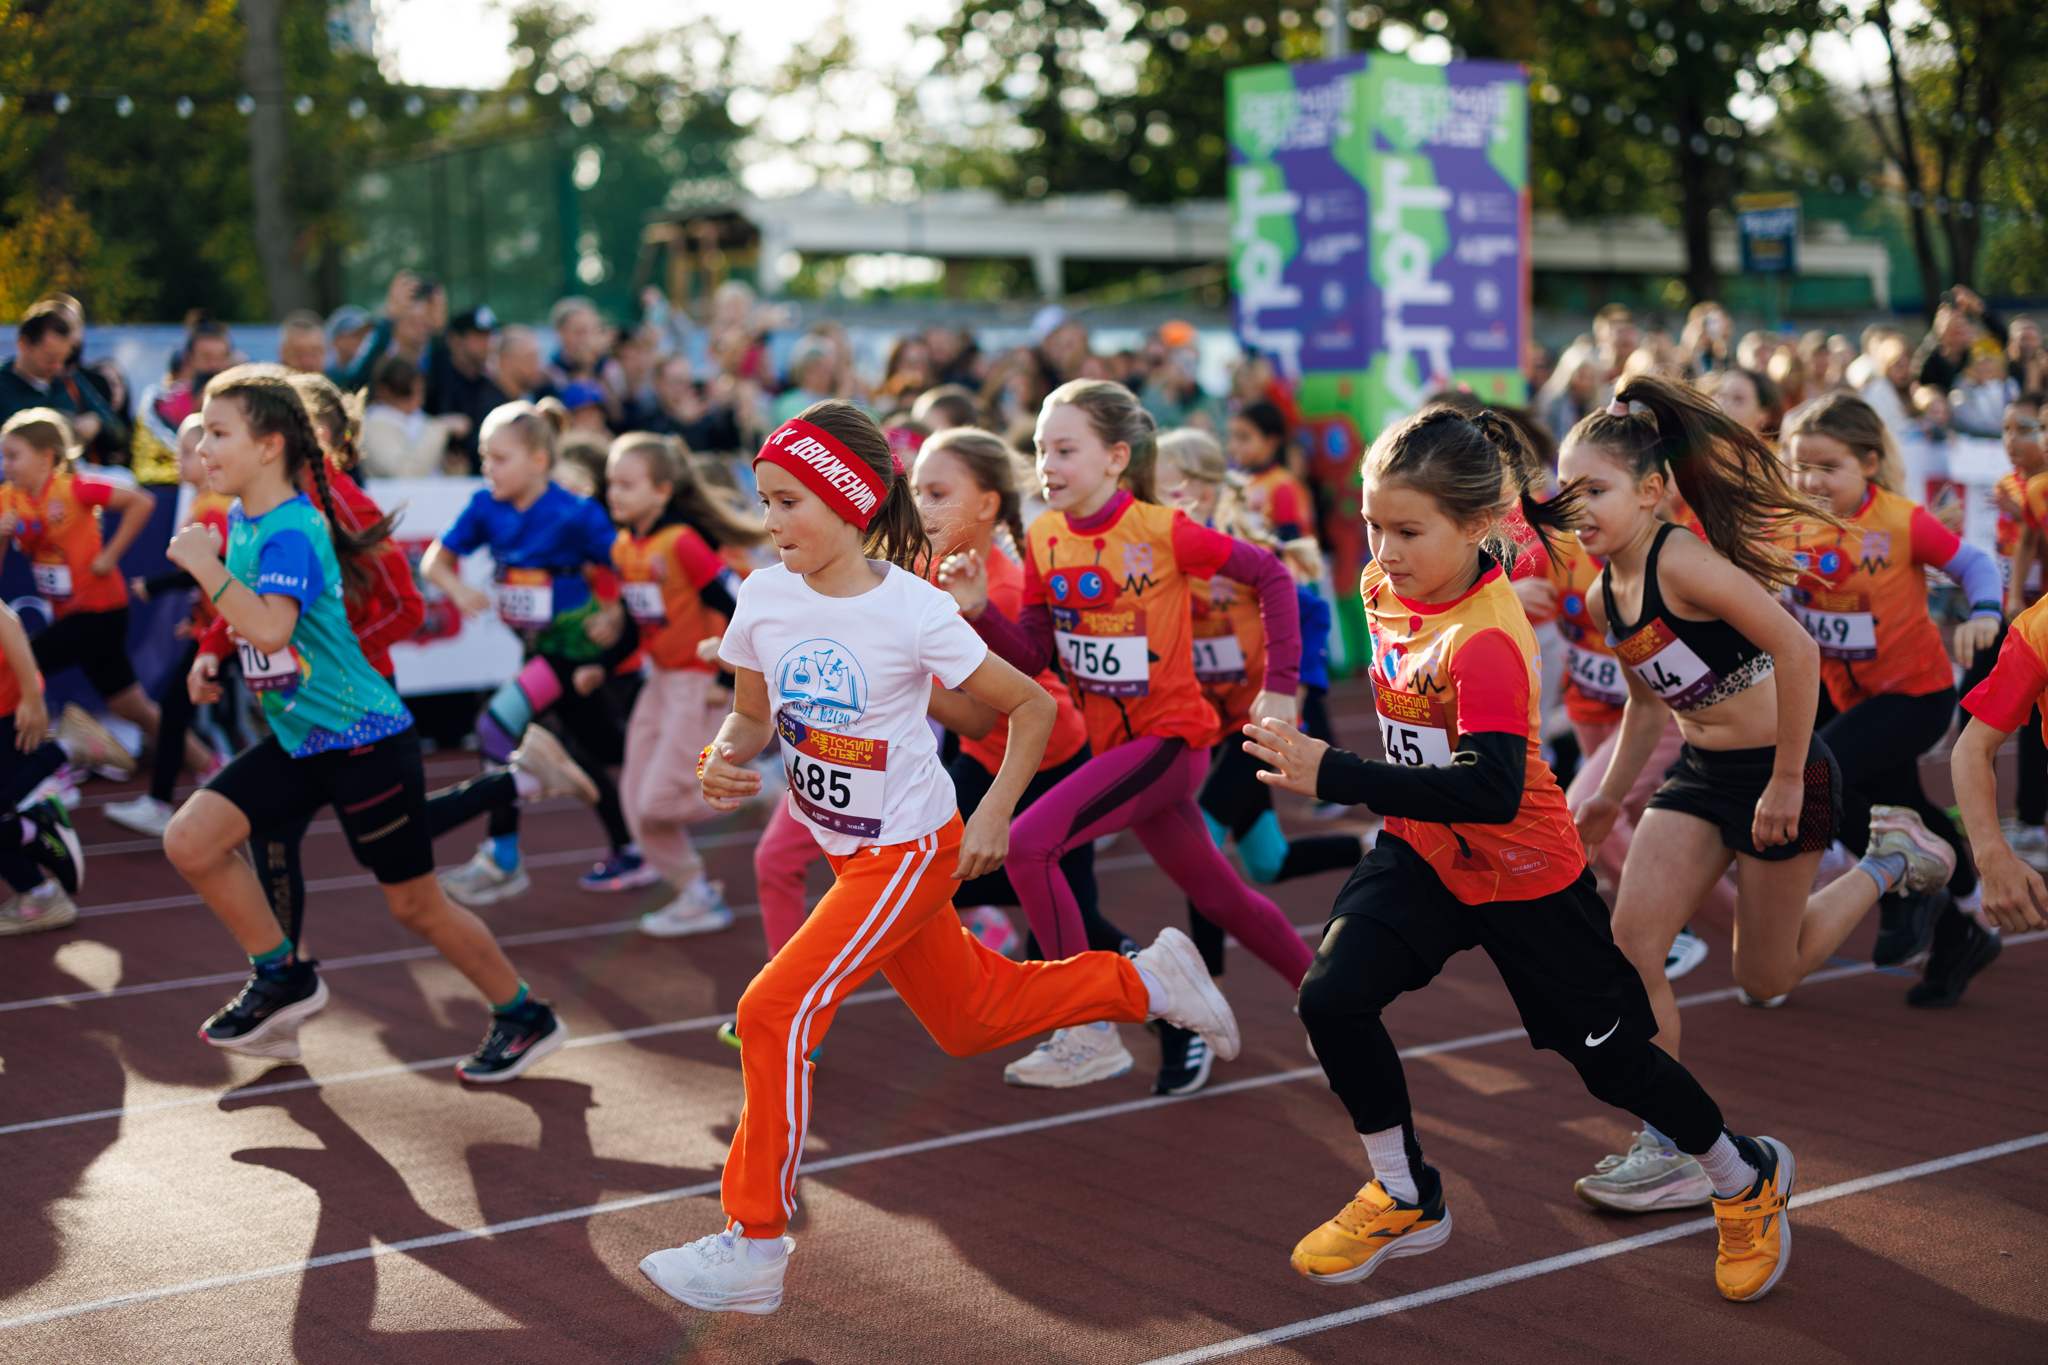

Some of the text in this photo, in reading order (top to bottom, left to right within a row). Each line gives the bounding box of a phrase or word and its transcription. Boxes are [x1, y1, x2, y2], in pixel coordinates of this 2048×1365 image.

[771, 428, 877, 515] К ДВИЖЕНИЮ
[1069, 640, 1120, 675] 756
[1639, 661, 1682, 694] 44
[1379, 687, 1430, 709] ДЕТСКИЙ
[811, 730, 874, 752] ДЕТСКИЙ
[819, 744, 863, 761] ЗАБЕГ
[1387, 725, 1423, 766] 45
[793, 755, 851, 808] 685
[847, 823, 867, 831] NORDIC
[1512, 861, 1541, 872] INSANITY
